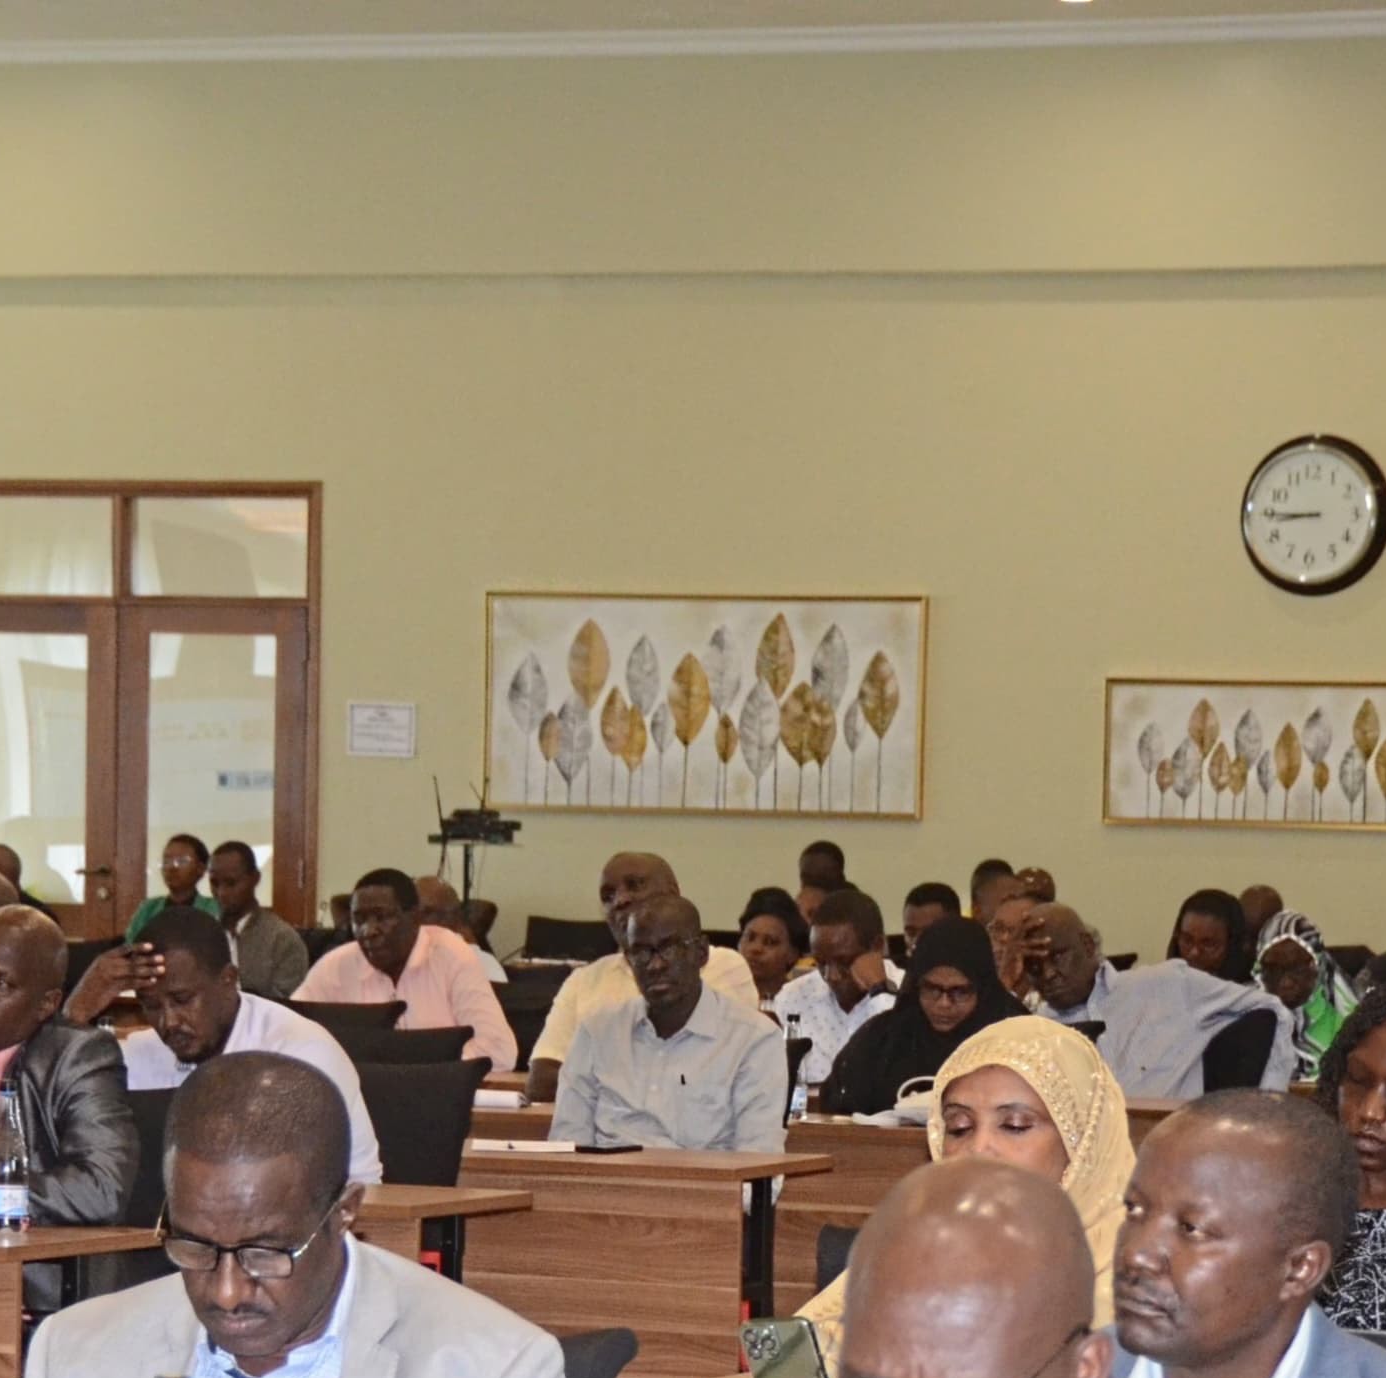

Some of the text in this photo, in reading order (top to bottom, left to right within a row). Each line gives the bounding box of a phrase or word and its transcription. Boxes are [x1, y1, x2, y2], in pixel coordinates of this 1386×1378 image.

[1287, 471, 1300, 486] 11
[1305, 463, 1322, 480] 12
[1330, 470, 1336, 486] 1
[1272, 487, 1289, 504] 10
[1343, 483, 1352, 499] 2
[1263, 507, 1276, 521] 9
[1353, 506, 1361, 522] 3
[1268, 528, 1280, 544] 8
[1341, 527, 1352, 544] 4
[1285, 543, 1296, 559] 7
[1303, 548, 1315, 566] 6
[1327, 543, 1338, 560] 5
